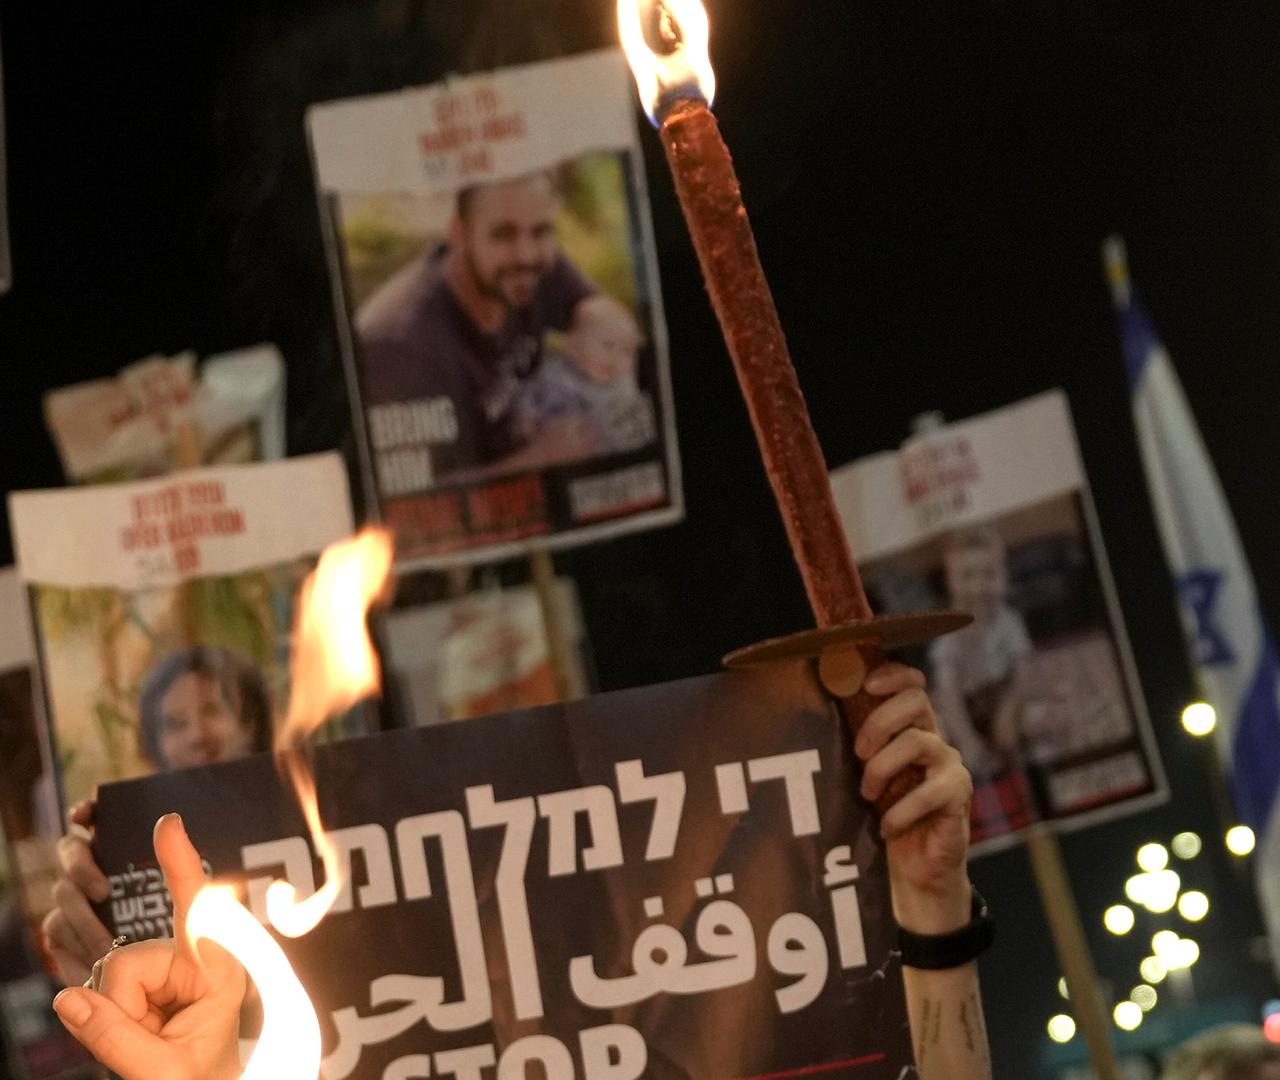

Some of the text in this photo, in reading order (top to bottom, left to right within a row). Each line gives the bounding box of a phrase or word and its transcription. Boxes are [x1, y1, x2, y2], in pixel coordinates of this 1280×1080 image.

[240, 749, 821, 925] די למלחמה
[568, 845, 868, 1015] أوقف
